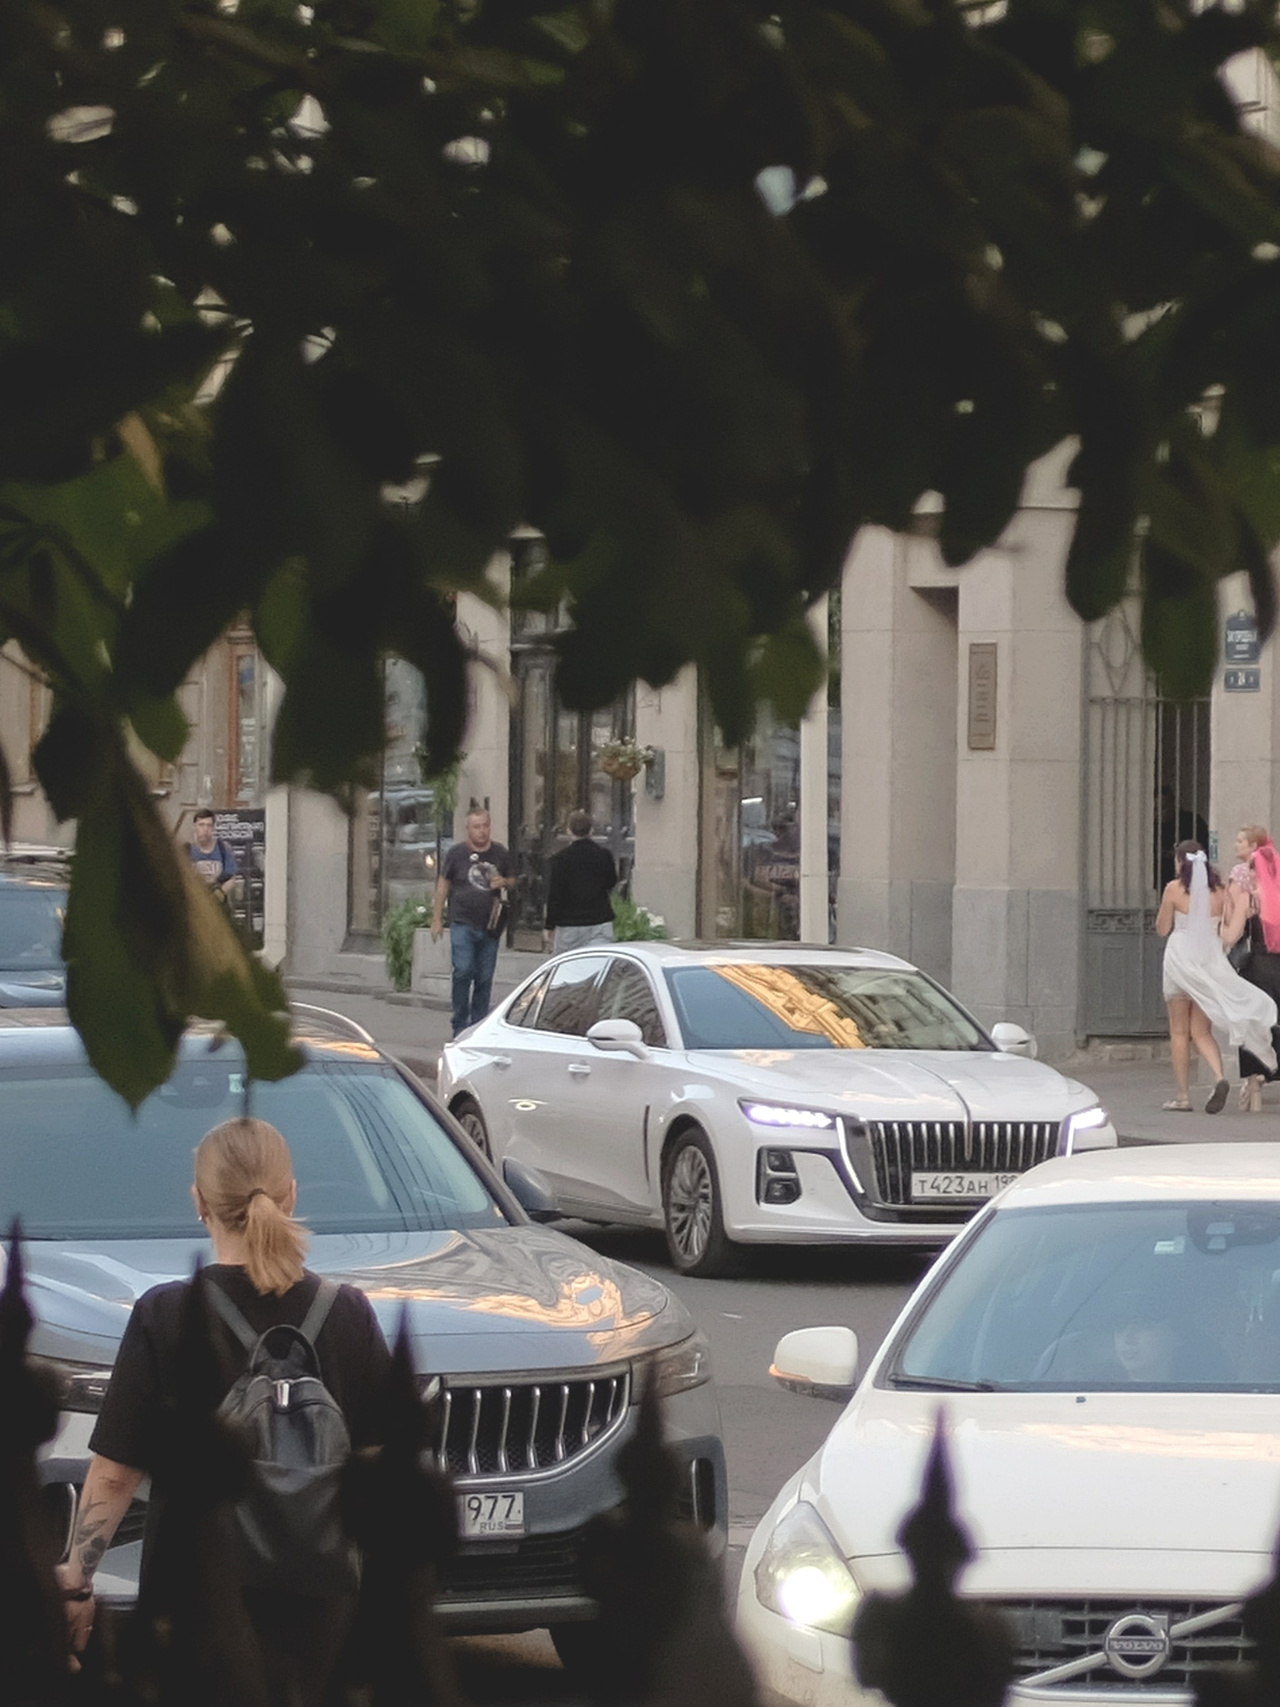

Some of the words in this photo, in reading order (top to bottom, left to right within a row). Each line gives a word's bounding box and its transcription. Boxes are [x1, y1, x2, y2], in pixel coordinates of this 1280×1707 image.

[467, 1494, 516, 1521] 977
[480, 1521, 505, 1531] RUS
[1109, 1640, 1163, 1651] VOLVO
